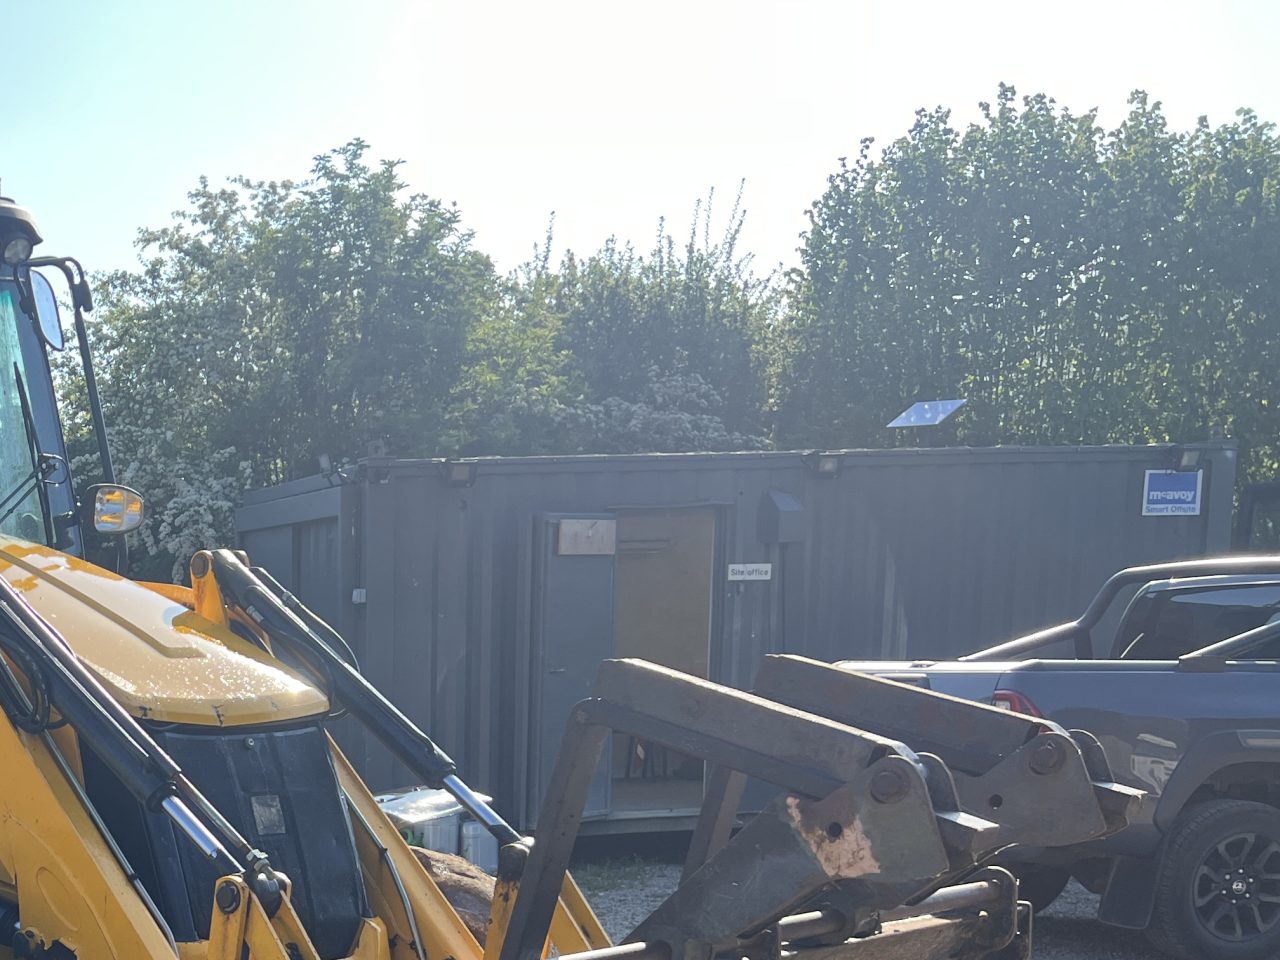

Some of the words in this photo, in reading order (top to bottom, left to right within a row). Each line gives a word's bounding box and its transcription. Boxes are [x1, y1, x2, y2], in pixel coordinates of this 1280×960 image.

[1145, 505, 1169, 513] Smart
[730, 568, 745, 576] Site
[746, 568, 769, 576] office
